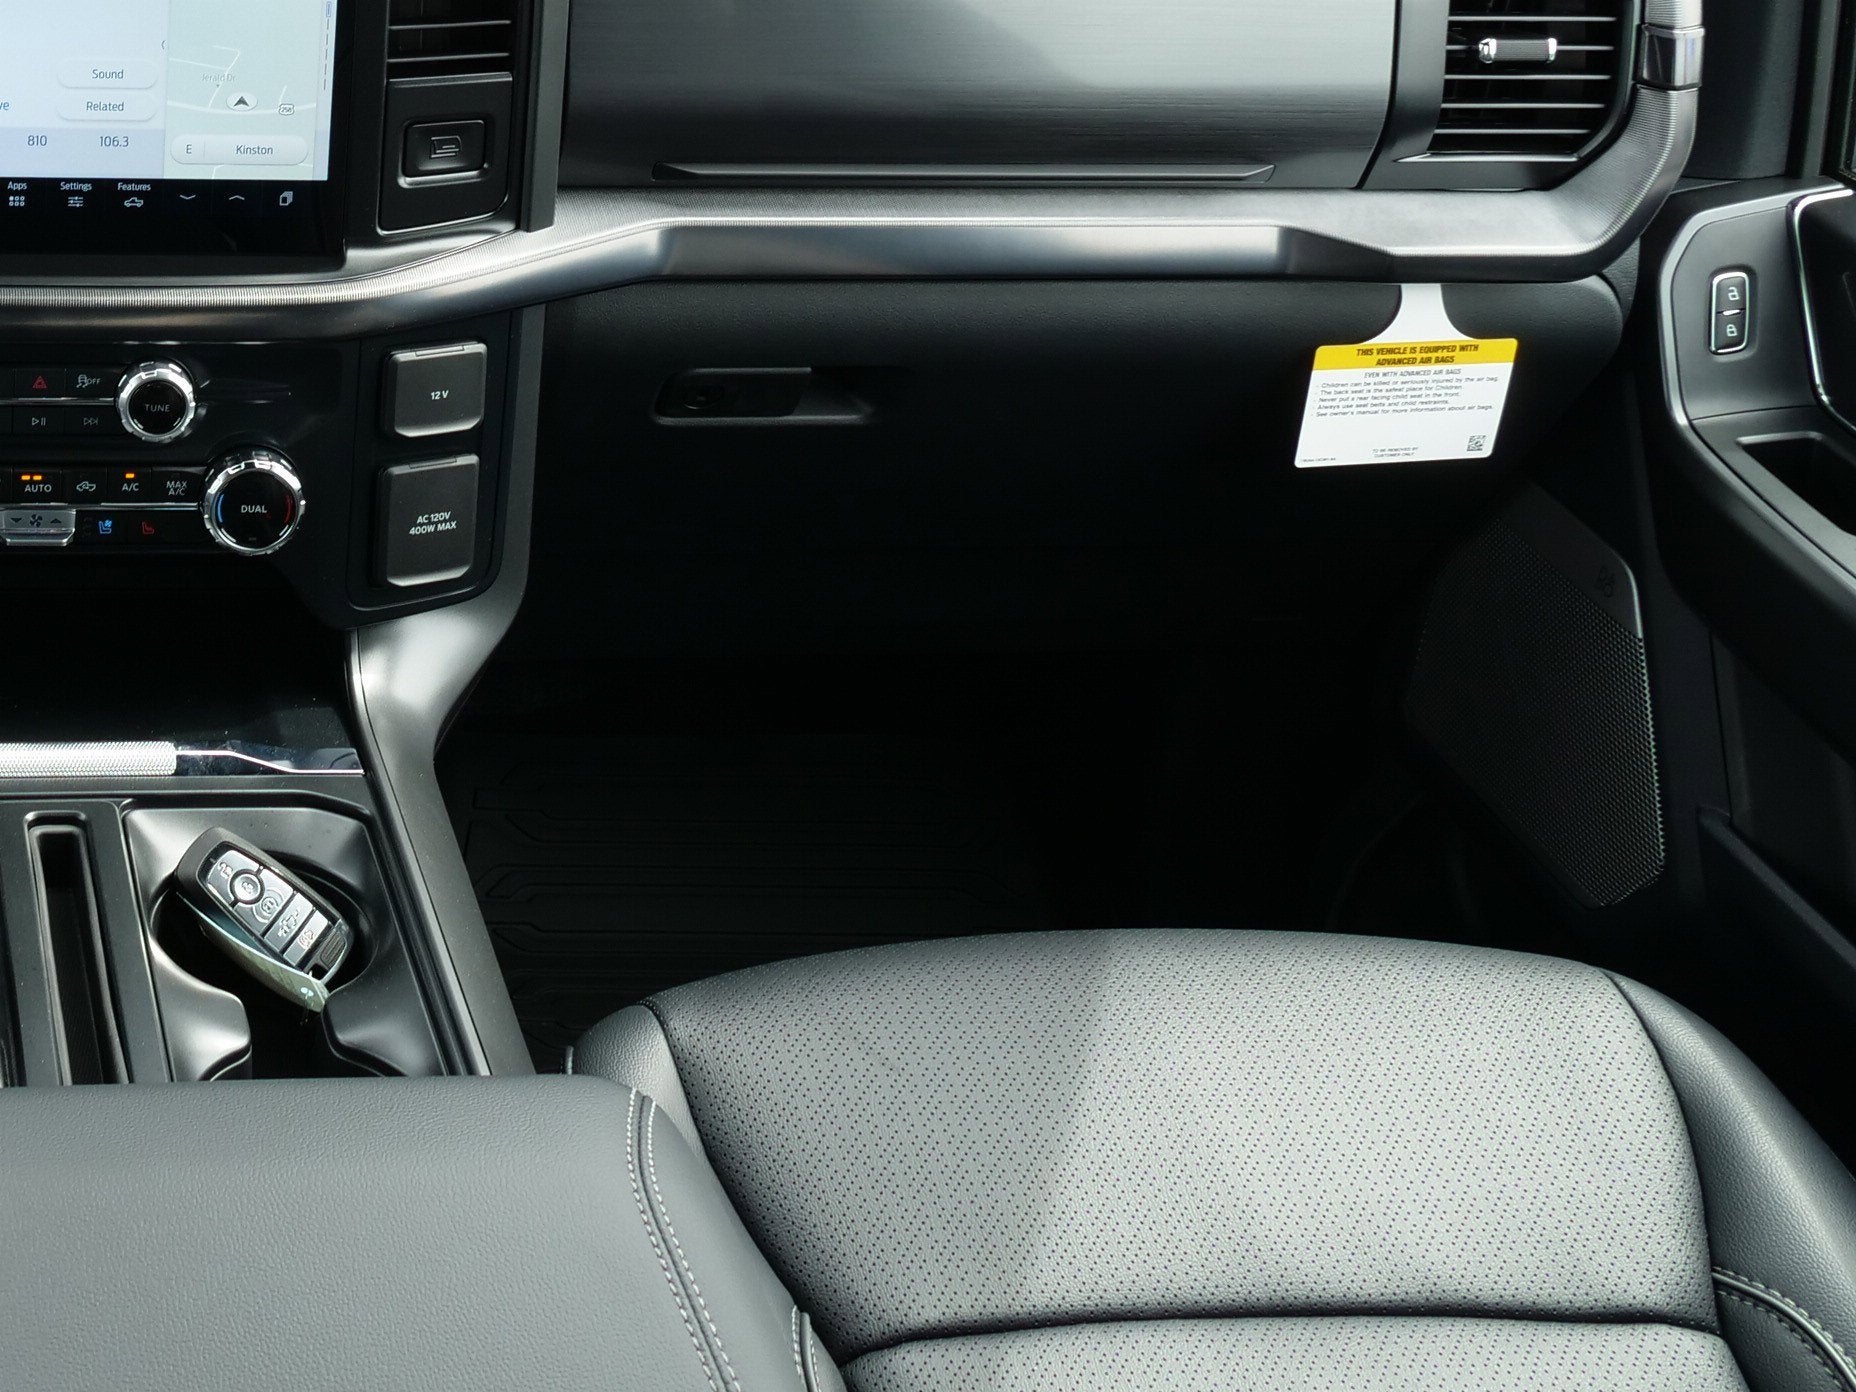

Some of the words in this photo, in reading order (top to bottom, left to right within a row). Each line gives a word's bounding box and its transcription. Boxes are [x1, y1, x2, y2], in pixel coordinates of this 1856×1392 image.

[92, 69, 124, 80] Sound
[86, 101, 124, 112] Related
[27, 135, 48, 147] 810
[99, 136, 129, 148] 106.3
[186, 145, 192, 154] E
[236, 145, 274, 156] Kinston
[7, 181, 27, 191] Apps
[60, 181, 92, 193] Settings
[117, 182, 151, 192] Features
[1356, 348, 1375, 357] THIS
[1376, 346, 1407, 356] VEHICLE
[1408, 346, 1418, 354] IS
[1419, 344, 1457, 354] EQUIPPED
[1458, 343, 1479, 352] WITH
[1375, 357, 1417, 367] ADVANCED
[1418, 357, 1433, 365] AIR
[1434, 356, 1455, 364] BAGS
[1364, 371, 1380, 379] EVEN
[87, 377, 101, 385] OFF
[430, 391, 441, 401] 12
[441, 390, 450, 399] V
[144, 403, 171, 413] TUNE
[24, 484, 52, 493] AUTO
[122, 483, 140, 492] A/C
[166, 480, 188, 489] MAX
[168, 487, 186, 496] A/C
[241, 504, 267, 514] DUAL
[416, 514, 429, 524] AC
[430, 511, 451, 522] 120V
[409, 524, 435, 536] 400W
[437, 520, 457, 532] MAX
